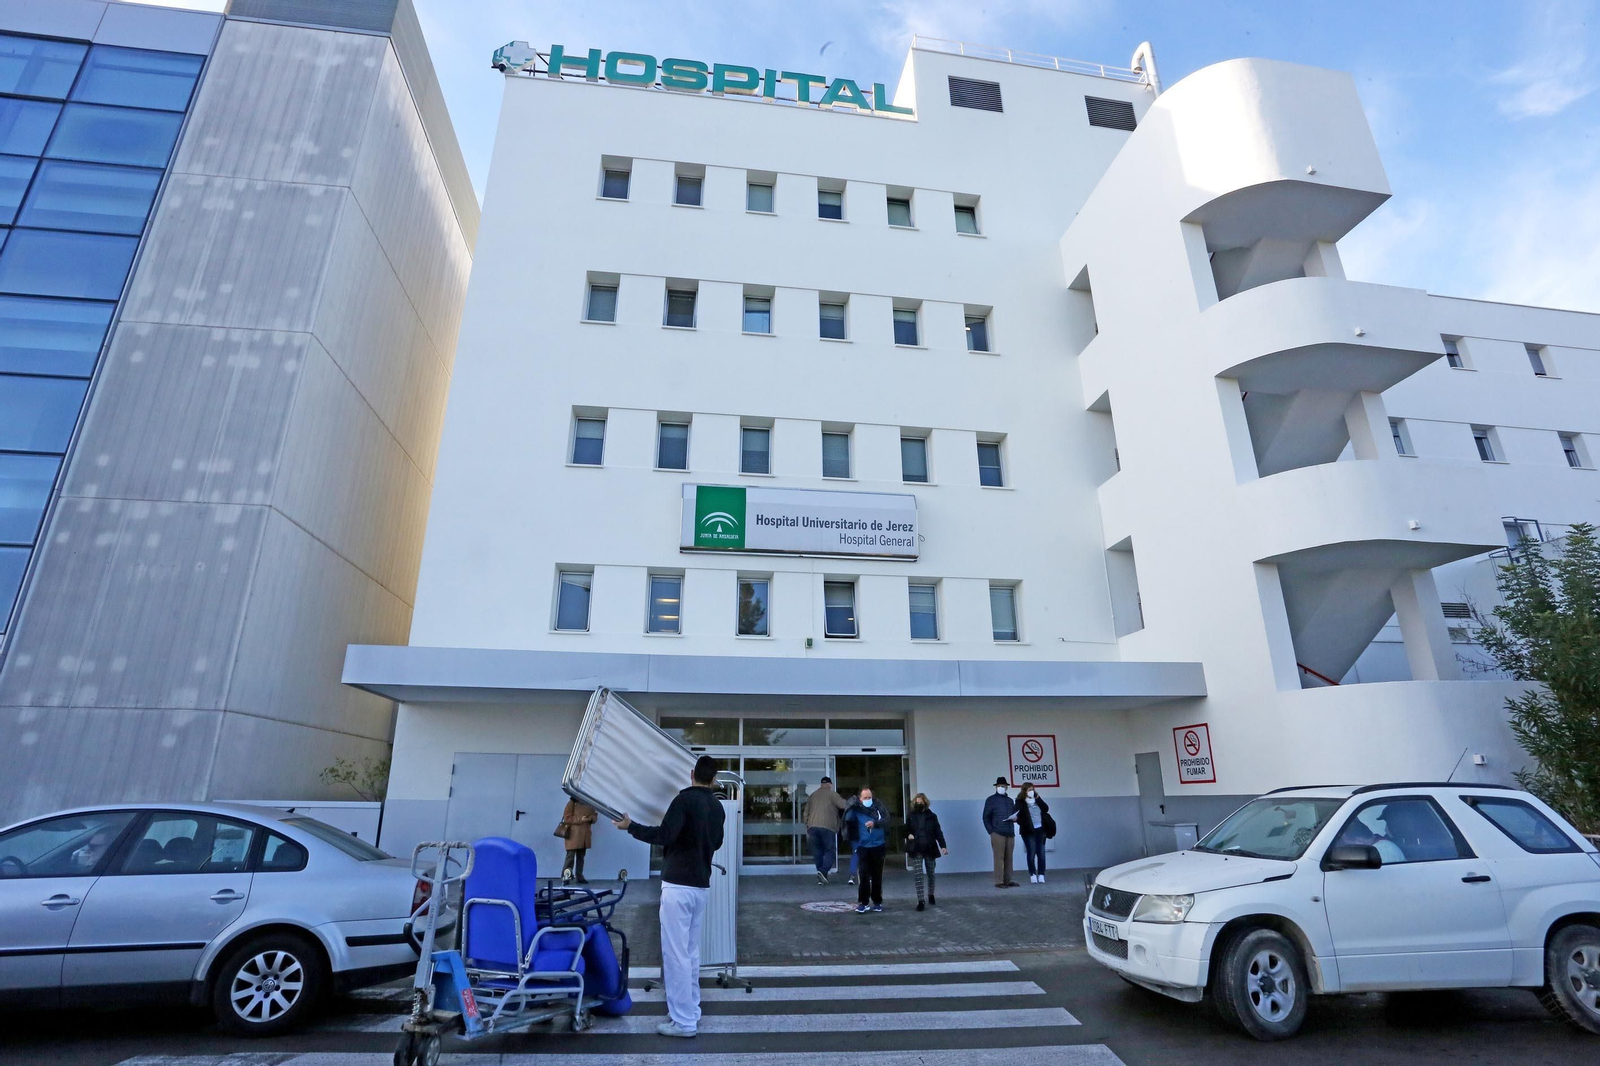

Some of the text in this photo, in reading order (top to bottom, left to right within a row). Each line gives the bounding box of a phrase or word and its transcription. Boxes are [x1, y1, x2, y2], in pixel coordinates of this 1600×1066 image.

[547, 44, 914, 115] HOSPITAL
[756, 514, 914, 532] Hospital Universitario de Jerez
[839, 533, 914, 547] Hospital General
[1180, 757, 1210, 767] PROHIBIDO
[1014, 764, 1054, 773] PROHIBIDO
[1186, 767, 1206, 776] FUMAR
[753, 796, 784, 804] Hospital
